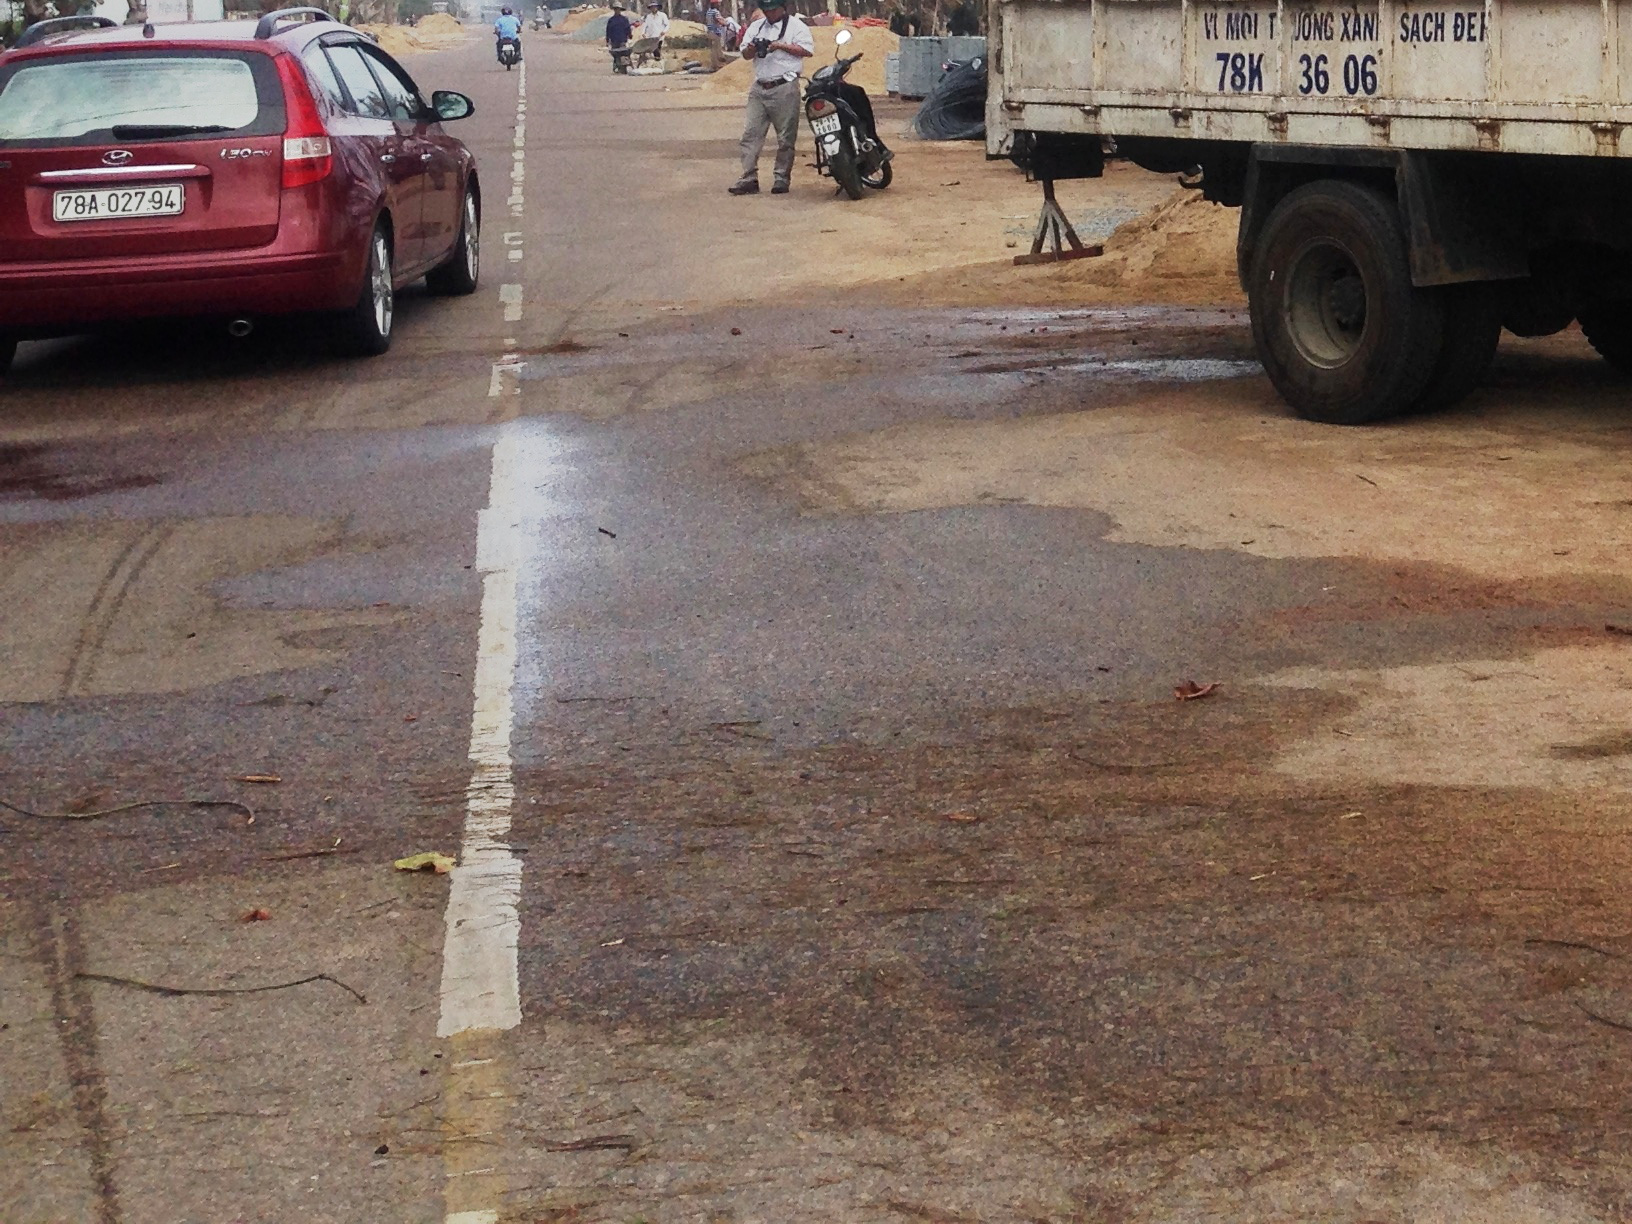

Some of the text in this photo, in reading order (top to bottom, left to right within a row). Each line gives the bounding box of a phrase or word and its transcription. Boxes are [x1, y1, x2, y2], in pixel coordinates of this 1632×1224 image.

[1340, 11, 1380, 42] XAN
[1215, 52, 1378, 96] 78K 36 06
